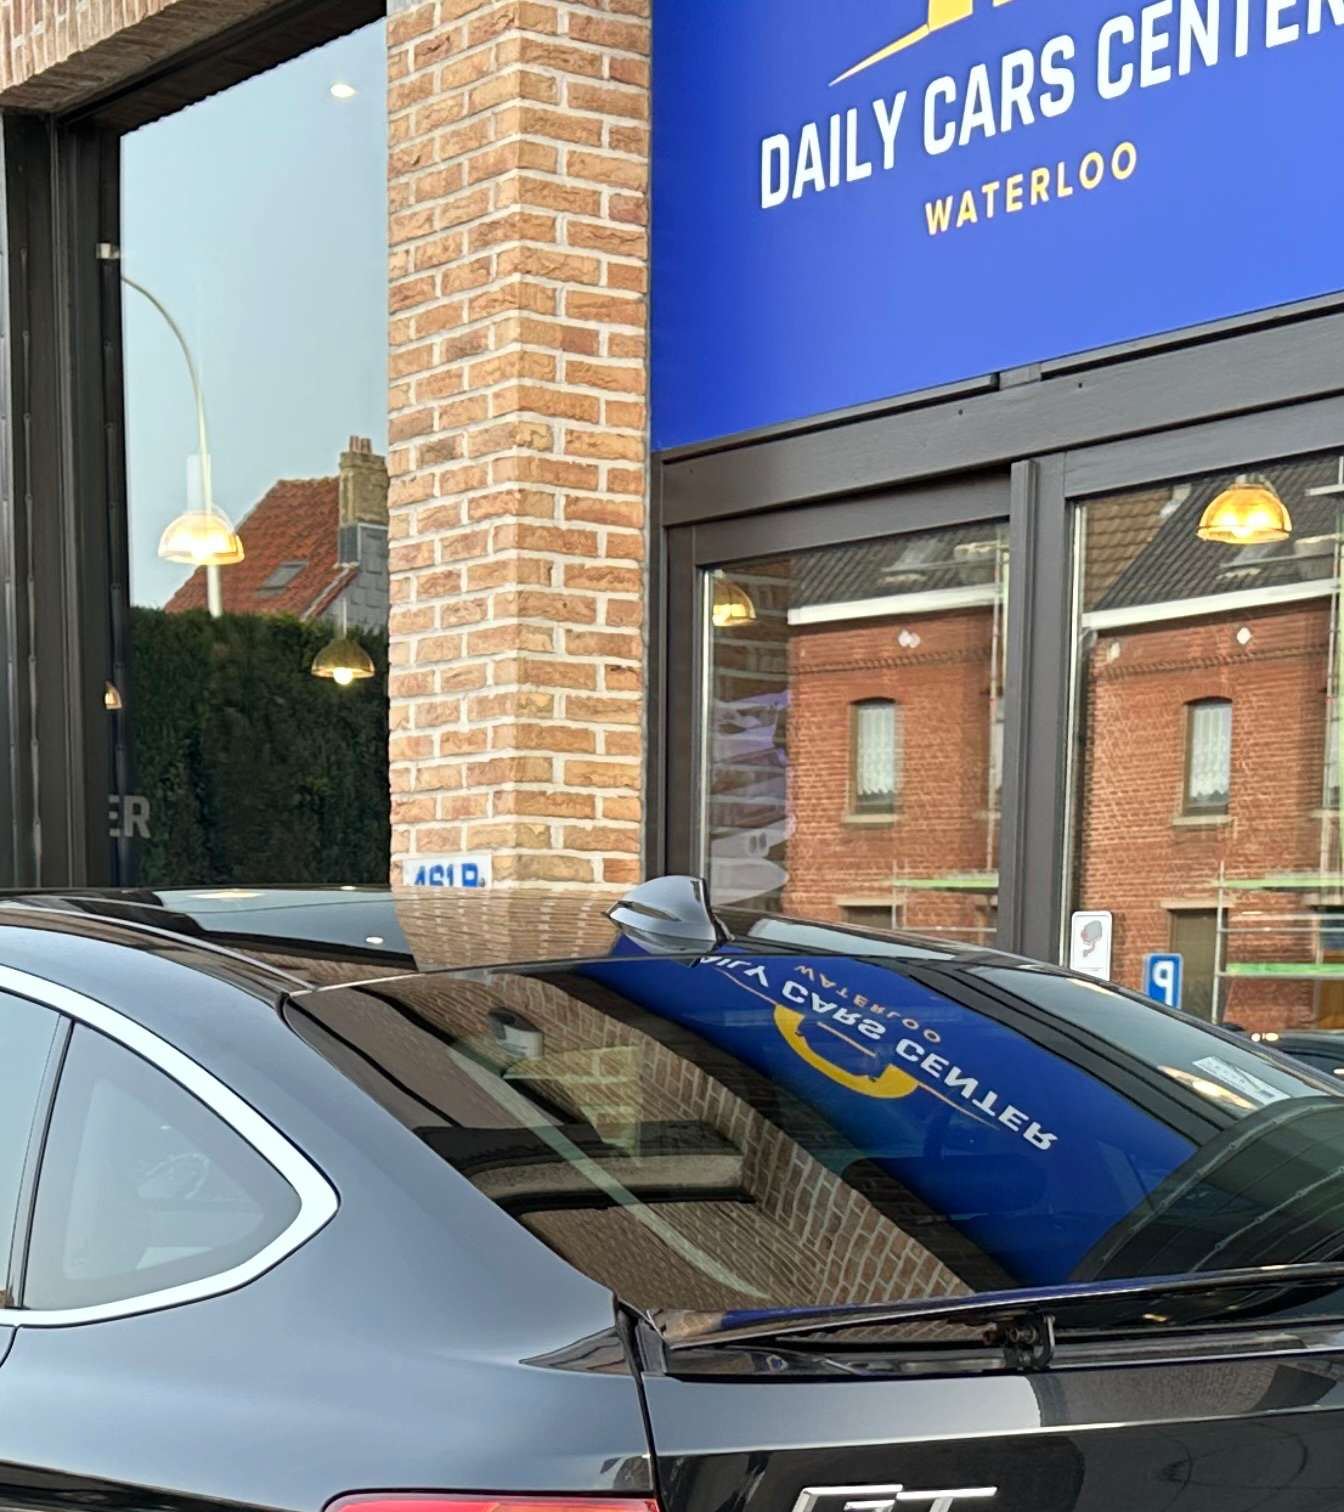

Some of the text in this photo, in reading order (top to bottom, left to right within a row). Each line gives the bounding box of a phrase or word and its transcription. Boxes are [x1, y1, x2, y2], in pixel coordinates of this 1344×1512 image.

[760, 91, 907, 209] DAILY
[923, 34, 1075, 156] CARS
[924, 141, 1138, 236] WATERLOO
